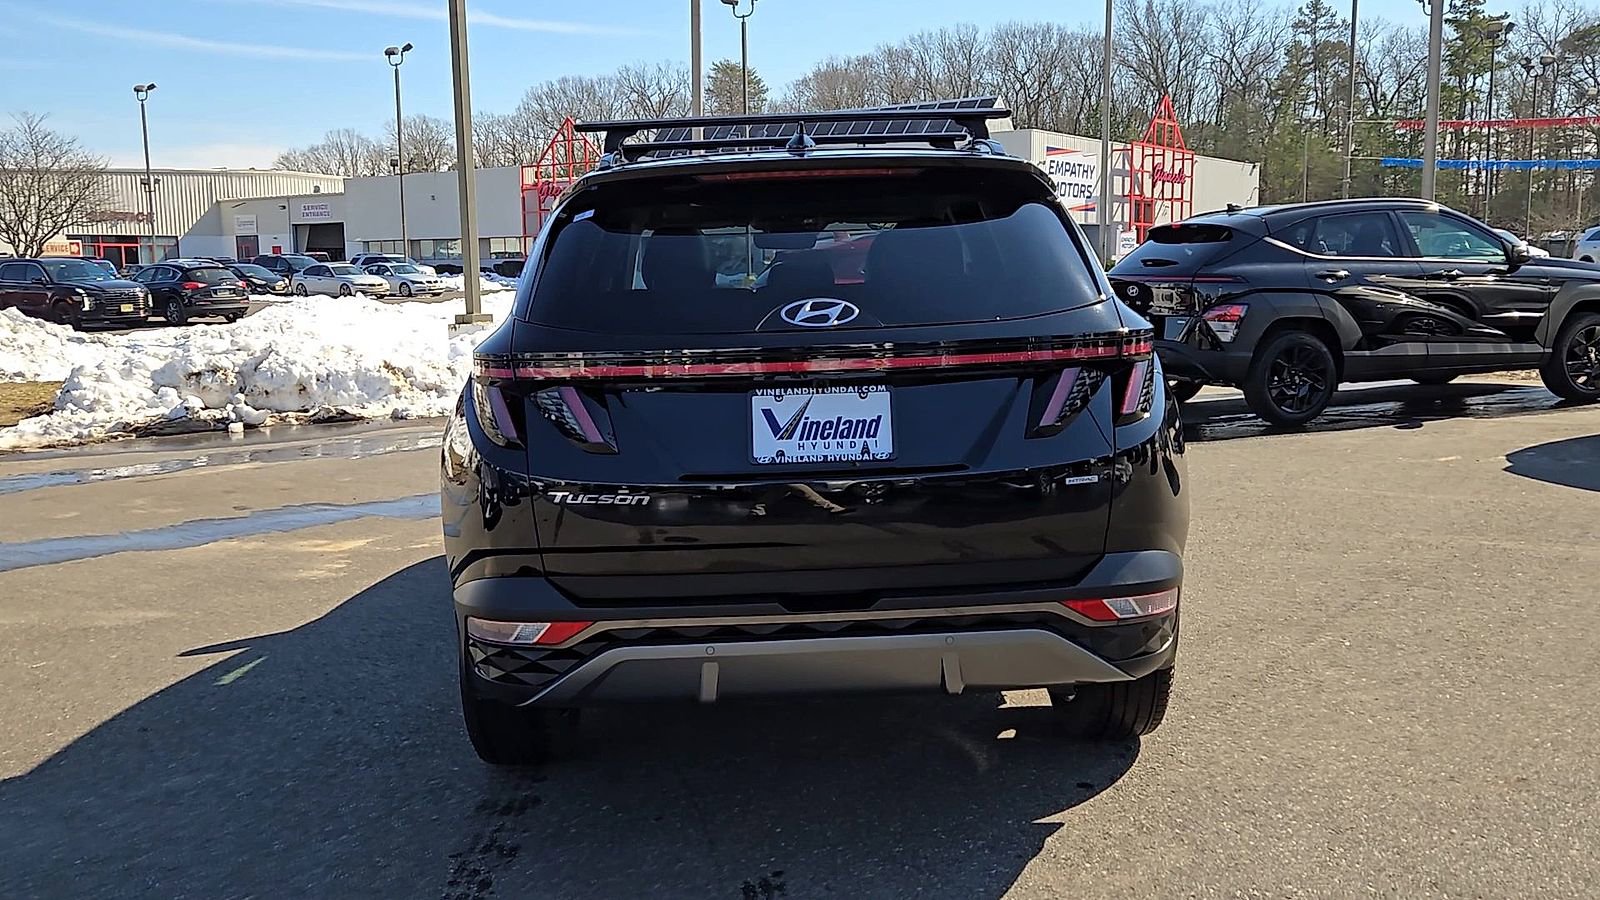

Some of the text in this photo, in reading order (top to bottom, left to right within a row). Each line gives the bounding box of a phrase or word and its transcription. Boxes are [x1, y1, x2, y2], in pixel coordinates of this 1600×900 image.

[1048, 159, 1096, 180] EMPATHY
[755, 384, 887, 396] VINELANDHYUNDAI.COM
[760, 395, 883, 441] Vineland
[797, 440, 879, 451] HYUNDAI
[773, 451, 873, 464] VINELAND HYUNDAI
